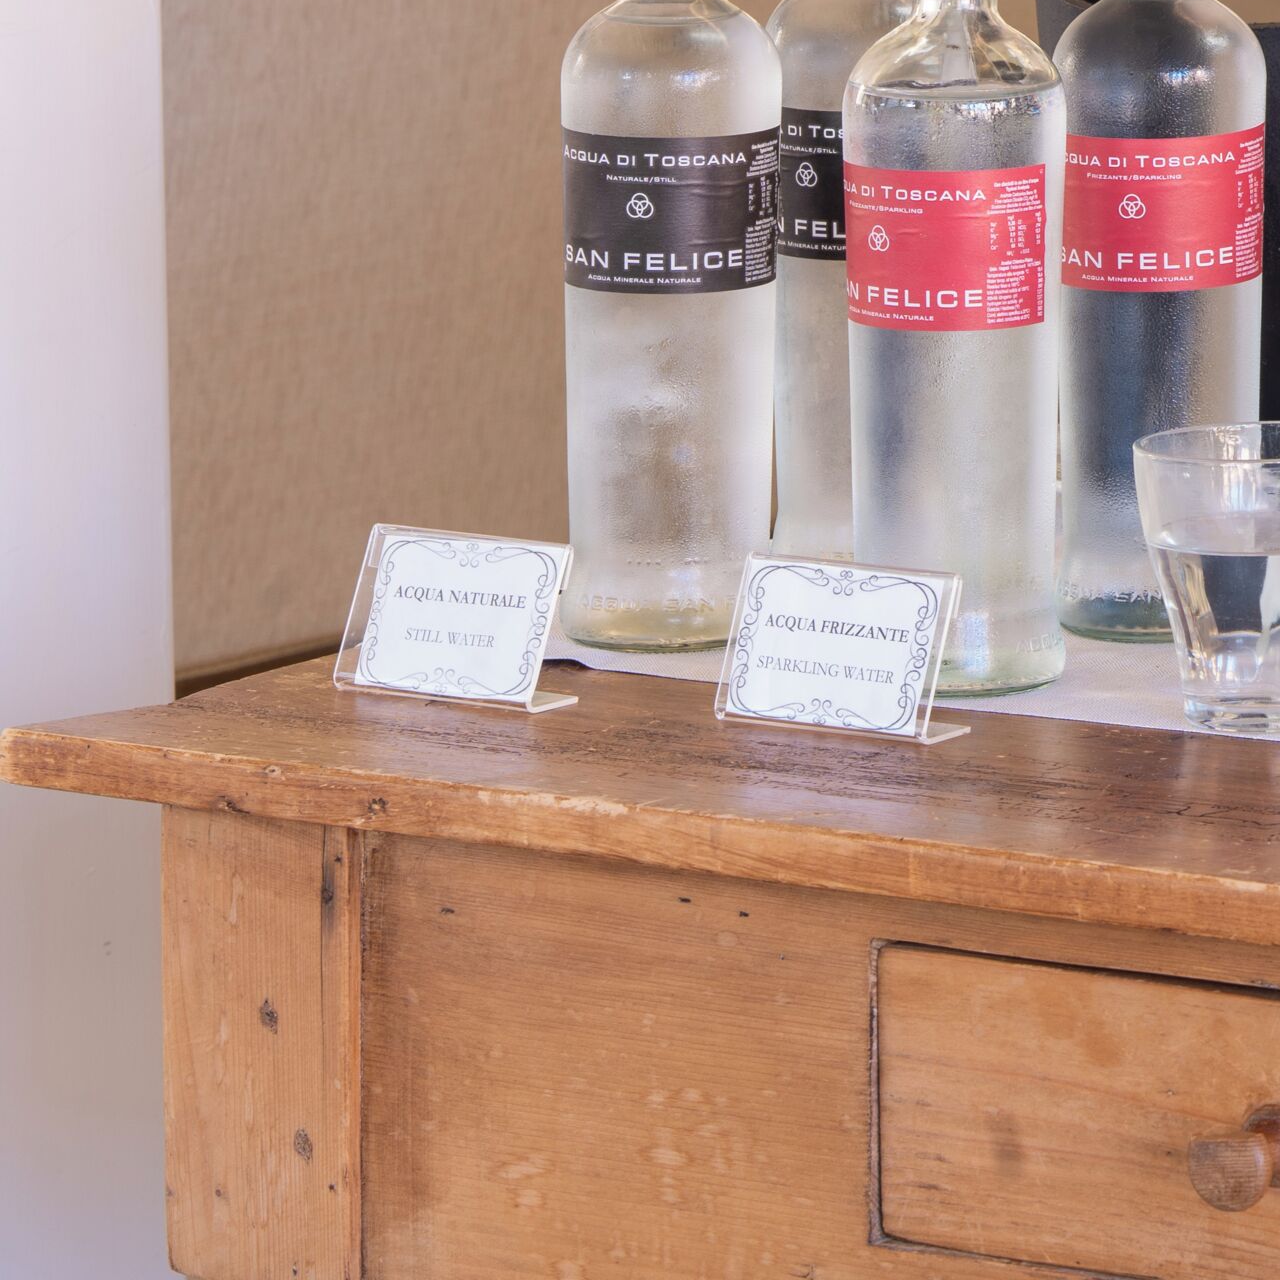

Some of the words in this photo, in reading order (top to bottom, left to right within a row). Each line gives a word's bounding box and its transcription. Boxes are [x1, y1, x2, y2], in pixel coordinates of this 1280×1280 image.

[787, 124, 802, 137] DI
[563, 143, 610, 165] ACQUA
[617, 154, 636, 167] DI
[644, 151, 747, 168] TOSCANA
[1108, 156, 1126, 168] DI
[1134, 151, 1235, 168] TOSCANA
[606, 173, 677, 184] NATURALE/STILL
[1086, 172, 1182, 181] FRIZZANTE/SPARKLING
[861, 185, 875, 198] DI
[880, 185, 987, 201] TOSCANA
[849, 199, 924, 214] FRIZZANTE/SPARKLING
[787, 240, 819, 250] MINERALE
[565, 243, 609, 269] SAN
[623, 248, 743, 271] FELICE
[1117, 246, 1234, 270] FELICE
[587, 273, 611, 282] ACQUA
[613, 276, 654, 284] MINERALE
[1082, 273, 1105, 282] ACQUA
[1107, 275, 1147, 283] MINERALE
[1150, 275, 1194, 283] NATURALE
[867, 285, 983, 308] FELICE
[892, 313, 934, 321] NATURALE
[394, 585, 444, 604] ACQUA
[447, 590, 527, 609] NATURALE
[765, 613, 817, 633] ACQUA
[820, 620, 910, 643] FRIZZANTE
[404, 627, 442, 644] STILL
[447, 632, 495, 648] WATER
[756, 655, 839, 678] SPARKLING
[843, 665, 895, 685] WATER
